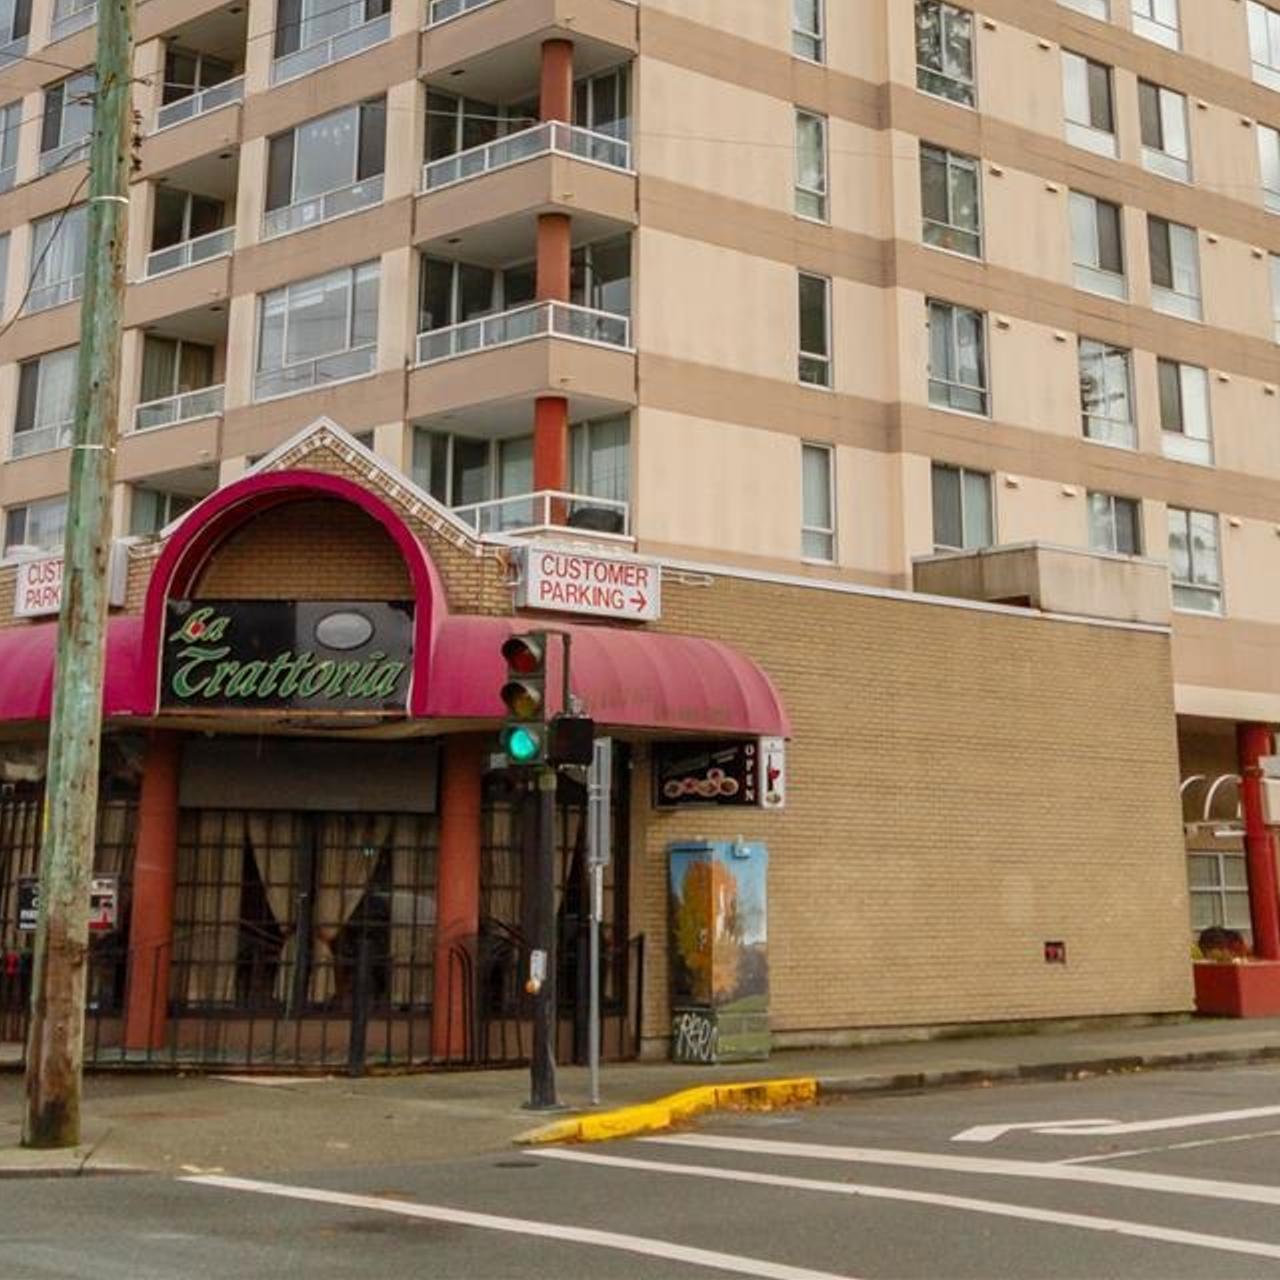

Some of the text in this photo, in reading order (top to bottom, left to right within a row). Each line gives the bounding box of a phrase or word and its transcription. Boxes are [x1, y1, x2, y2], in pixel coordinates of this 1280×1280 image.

[27, 560, 64, 585] CUST
[541, 553, 649, 588] CUSTOMER
[24, 585, 61, 609] PARK
[540, 579, 625, 609] PARKING
[169, 606, 231, 644] La
[172, 645, 404, 699] Trattoria
[745, 743, 755, 801] OPEN
